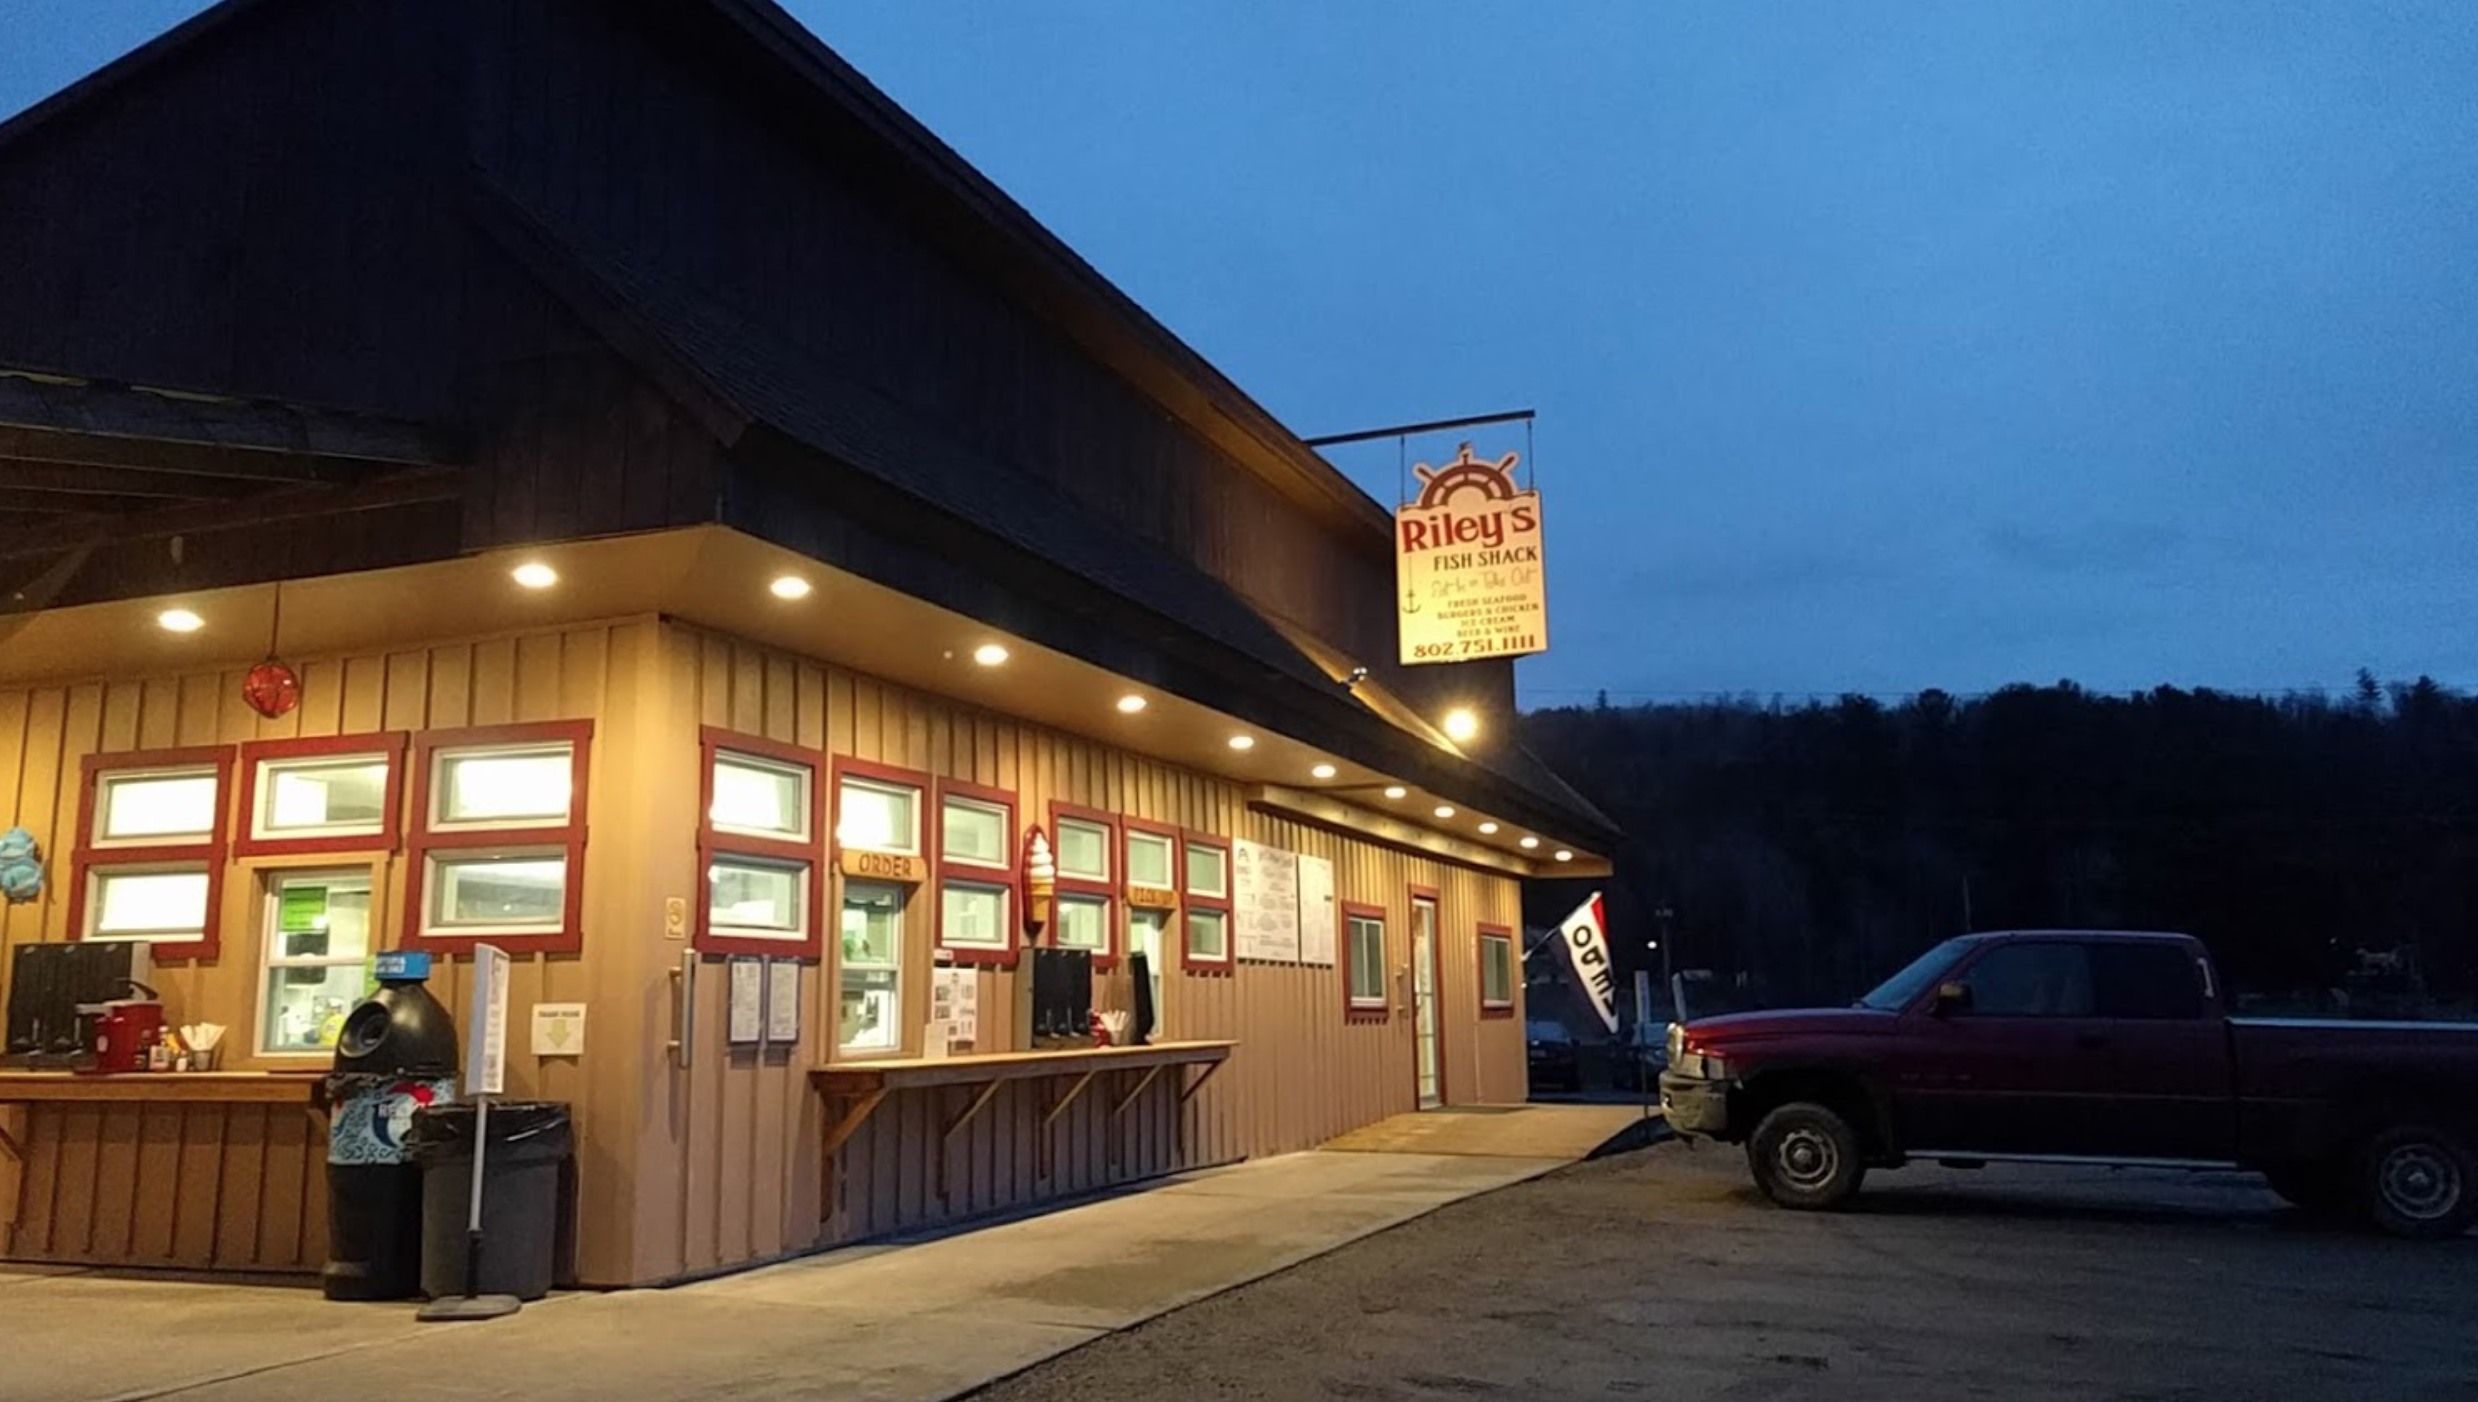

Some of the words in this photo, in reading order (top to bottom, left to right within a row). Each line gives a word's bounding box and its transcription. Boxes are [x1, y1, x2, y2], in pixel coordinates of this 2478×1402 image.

[1401, 506, 1537, 554] Riley's
[1433, 554, 1473, 572] FISH
[1477, 545, 1538, 568] SHACK
[1437, 607, 1483, 620] BURGERS
[1485, 607, 1493, 615] &
[1495, 602, 1540, 615] CHICKEN
[1447, 597, 1479, 608] FRESH
[1482, 593, 1528, 605] SEAFOOD
[1457, 628, 1482, 638] BEER
[1494, 624, 1521, 634] WINE
[1461, 618, 1477, 627] ICE
[1479, 615, 1516, 626] CREAM
[1413, 634, 1536, 659] 802.751.1111
[858, 852, 912, 877] ORDER
